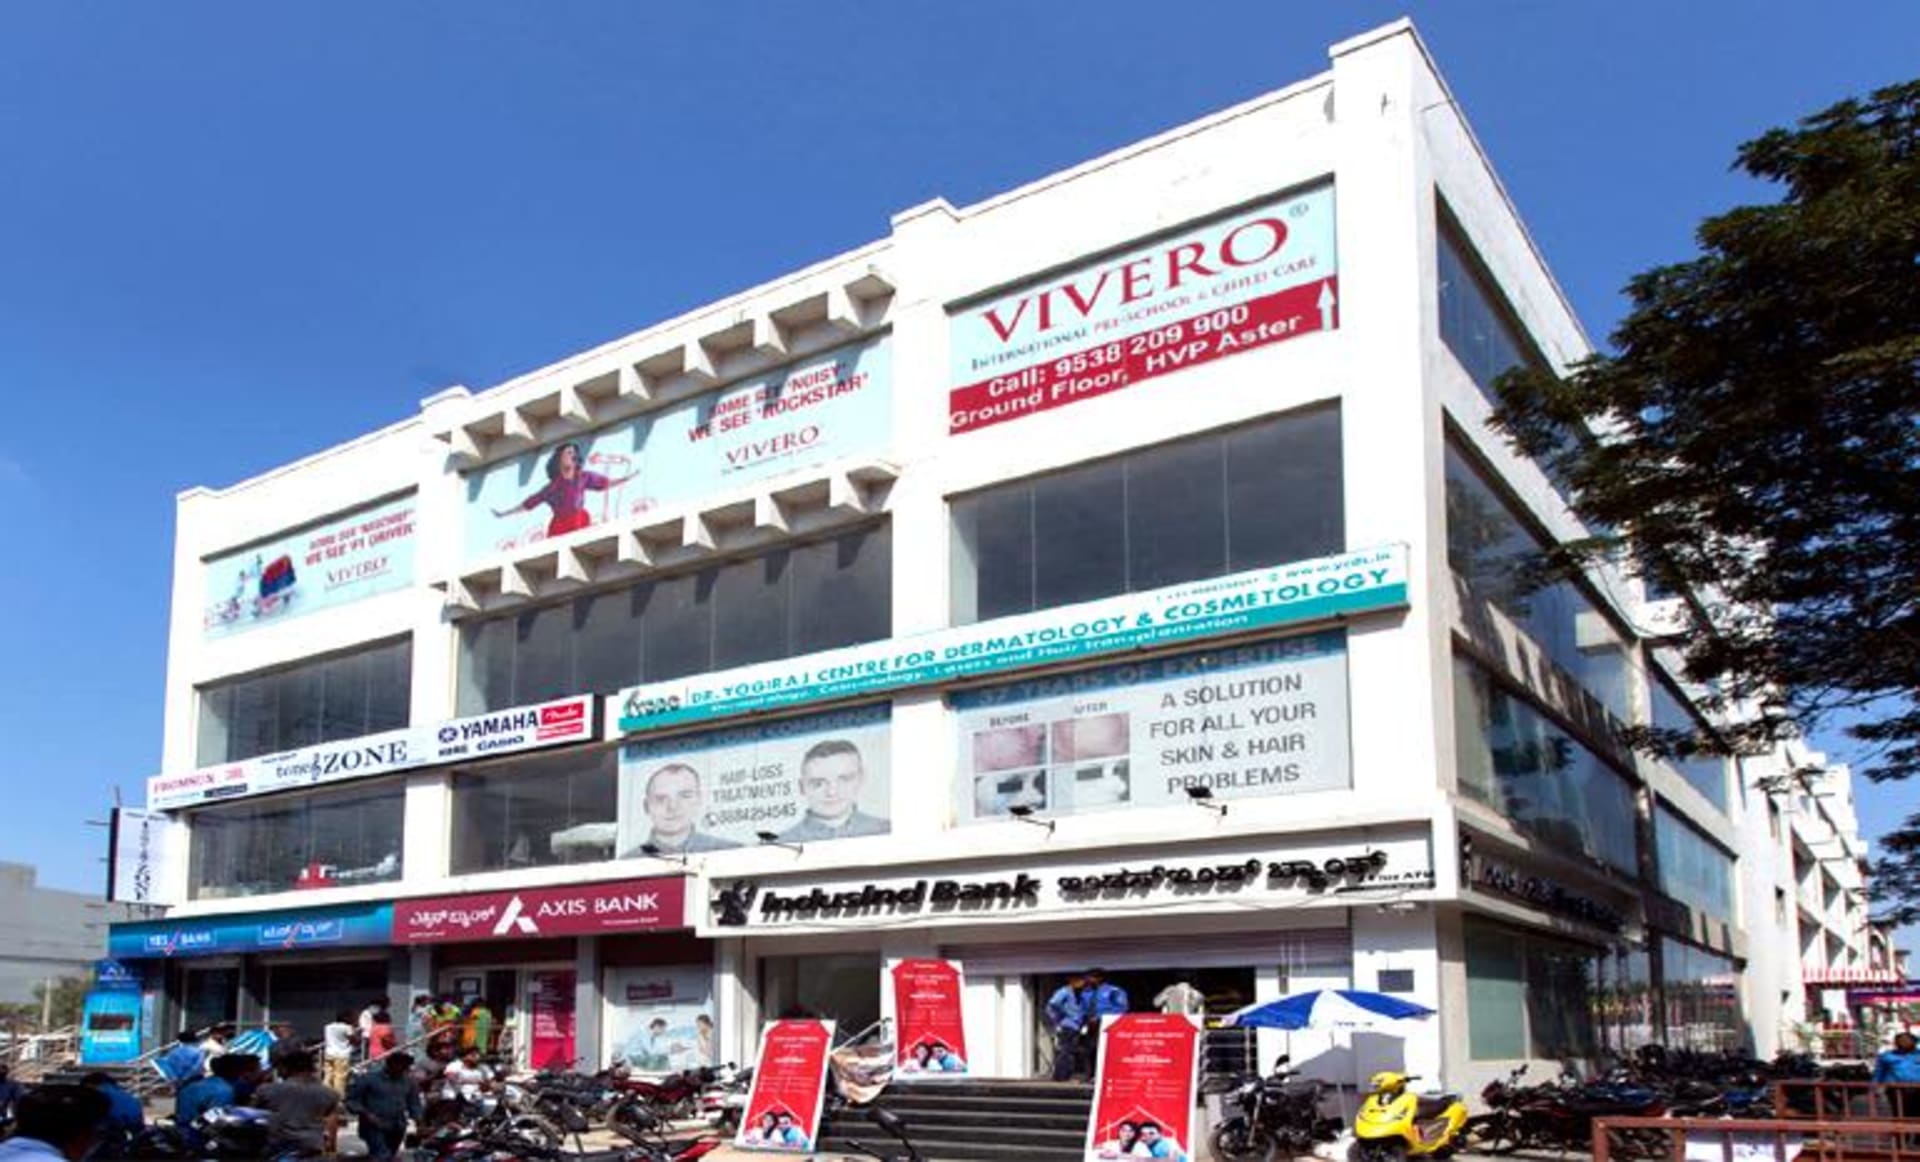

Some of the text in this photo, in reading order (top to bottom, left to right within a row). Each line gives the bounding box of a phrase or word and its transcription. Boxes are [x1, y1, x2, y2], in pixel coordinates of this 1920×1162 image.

[982, 218, 1288, 343] VIVERO
[988, 304, 1249, 397] Call: 9538 209 900
[950, 315, 1303, 429] Ground Floor, HVP Aster
[719, 411, 751, 433] SEE
[726, 425, 820, 464] VIVERO
[817, 658, 888, 682] CENTRE
[894, 651, 935, 668] FOR
[945, 615, 1126, 659] DERMATOLOGY
[1136, 612, 1153, 626] &
[1164, 568, 1389, 620] COSMETOLOGY
[1160, 673, 1302, 709] A SOLUTION
[461, 711, 539, 740] YAMAHA
[1150, 702, 1317, 739] FOR ALL YOUR
[323, 740, 407, 775] ZONE
[1160, 733, 1306, 767] SKIN & HAIR
[1167, 764, 1301, 795] PROBLEMS
[537, 892, 659, 918] AXIS BANK
[761, 873, 1041, 914] IndusInd Bank
